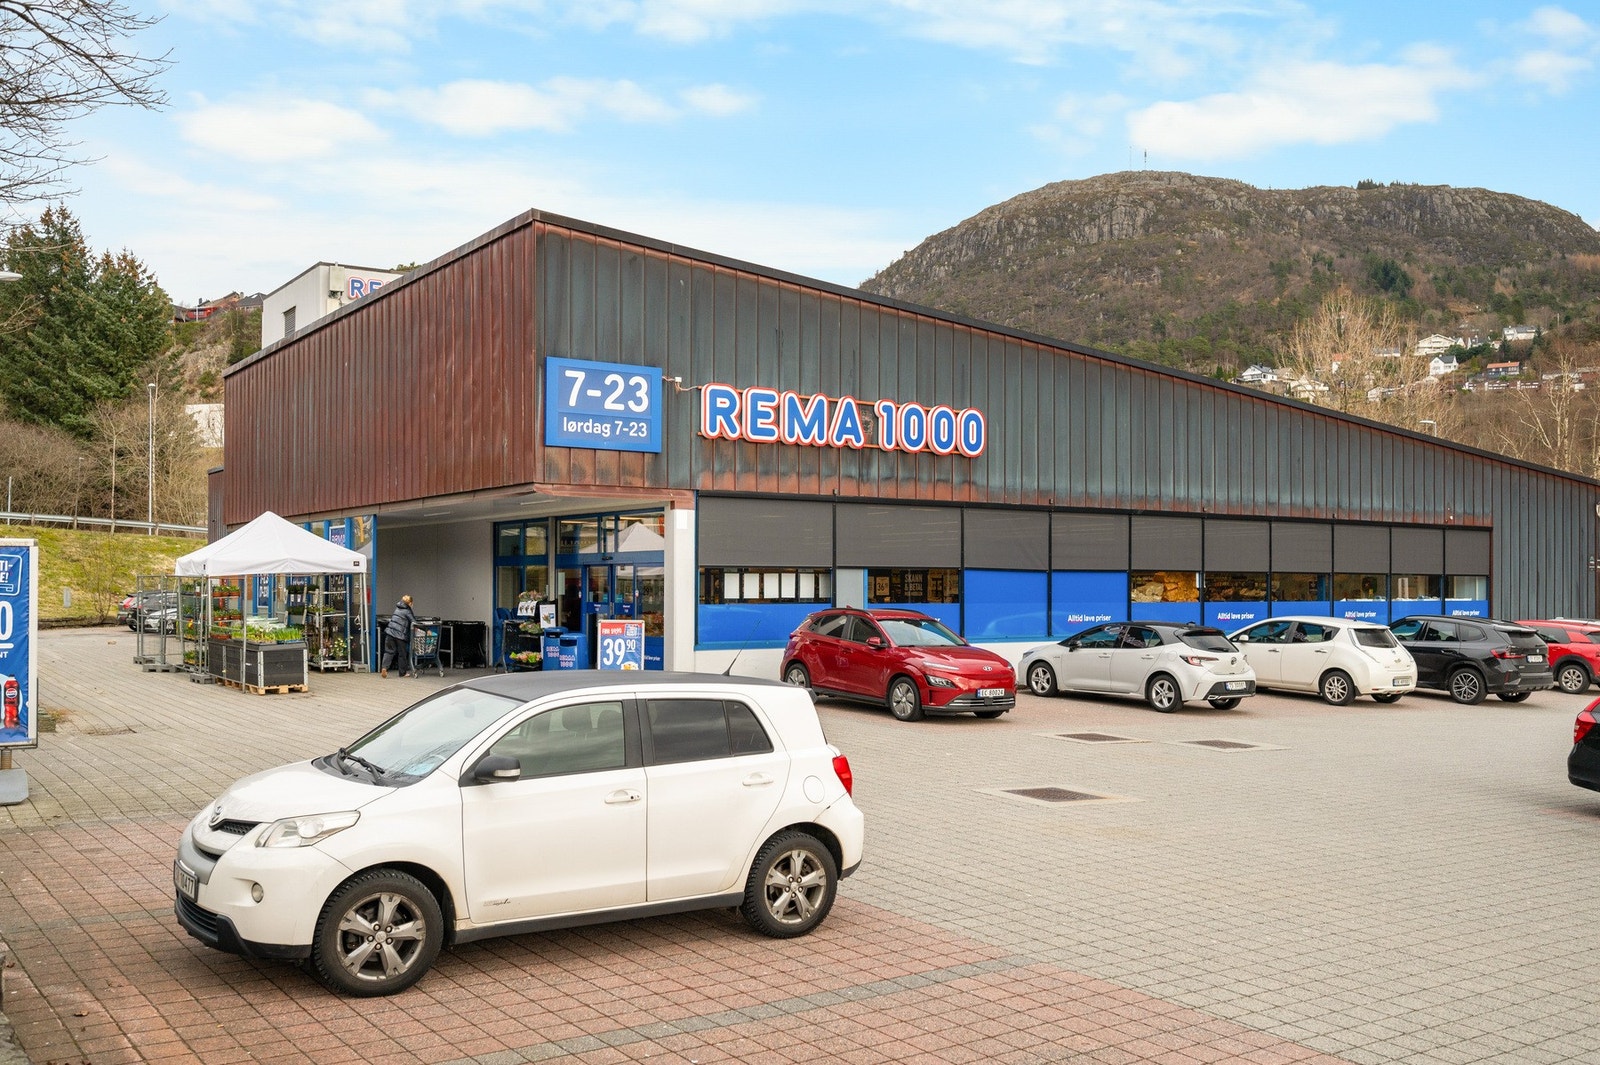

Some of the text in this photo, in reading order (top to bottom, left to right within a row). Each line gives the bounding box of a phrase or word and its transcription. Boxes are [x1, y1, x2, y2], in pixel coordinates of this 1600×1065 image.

[565, 370, 649, 412] 7-23
[563, 417, 648, 438] lørdag 7-23
[701, 382, 987, 458] REMA 1000
[1068, 614, 1111, 622] Alltid lave priser
[603, 638, 636, 665] 39 90
